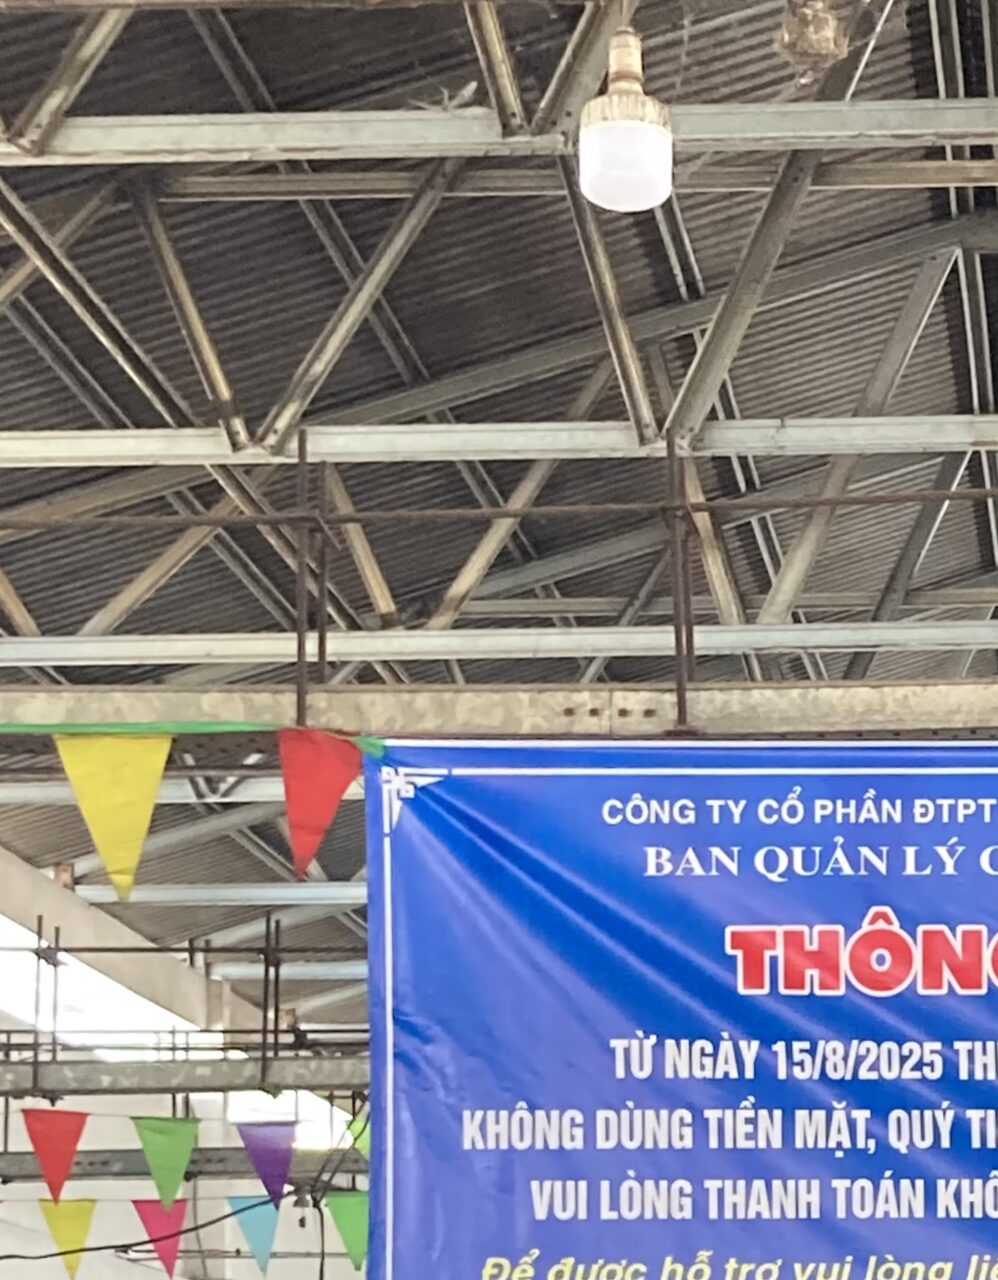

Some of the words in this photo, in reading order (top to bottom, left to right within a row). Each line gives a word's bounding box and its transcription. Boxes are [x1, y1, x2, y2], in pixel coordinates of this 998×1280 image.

[602, 793, 695, 824] CÔNG
[706, 800, 746, 823] TY
[758, 786, 804, 824] CỔ
[815, 789, 901, 823] PHẦN
[913, 799, 997, 823] ĐTPT
[644, 847, 739, 876] BAN
[755, 836, 888, 882] QUẢN
[903, 837, 965, 875] LÝ
[610, 1030, 656, 1078] TỪ
[665, 1031, 759, 1078] NGÀY
[772, 1040, 942, 1079] 15/8/2025
[463, 1102, 583, 1150] KHÔNG
[596, 1101, 692, 1149] DÙNG
[704, 1097, 782, 1148] TIỀN
[795, 1101, 875, 1157] MẶT,
[888, 1101, 955, 1153] QUÝ
[531, 1180, 587, 1220] VUI
[601, 1170, 692, 1219] LÒNG
[704, 1180, 820, 1219] THANH
[831, 1171, 924, 1218] TOÁN
